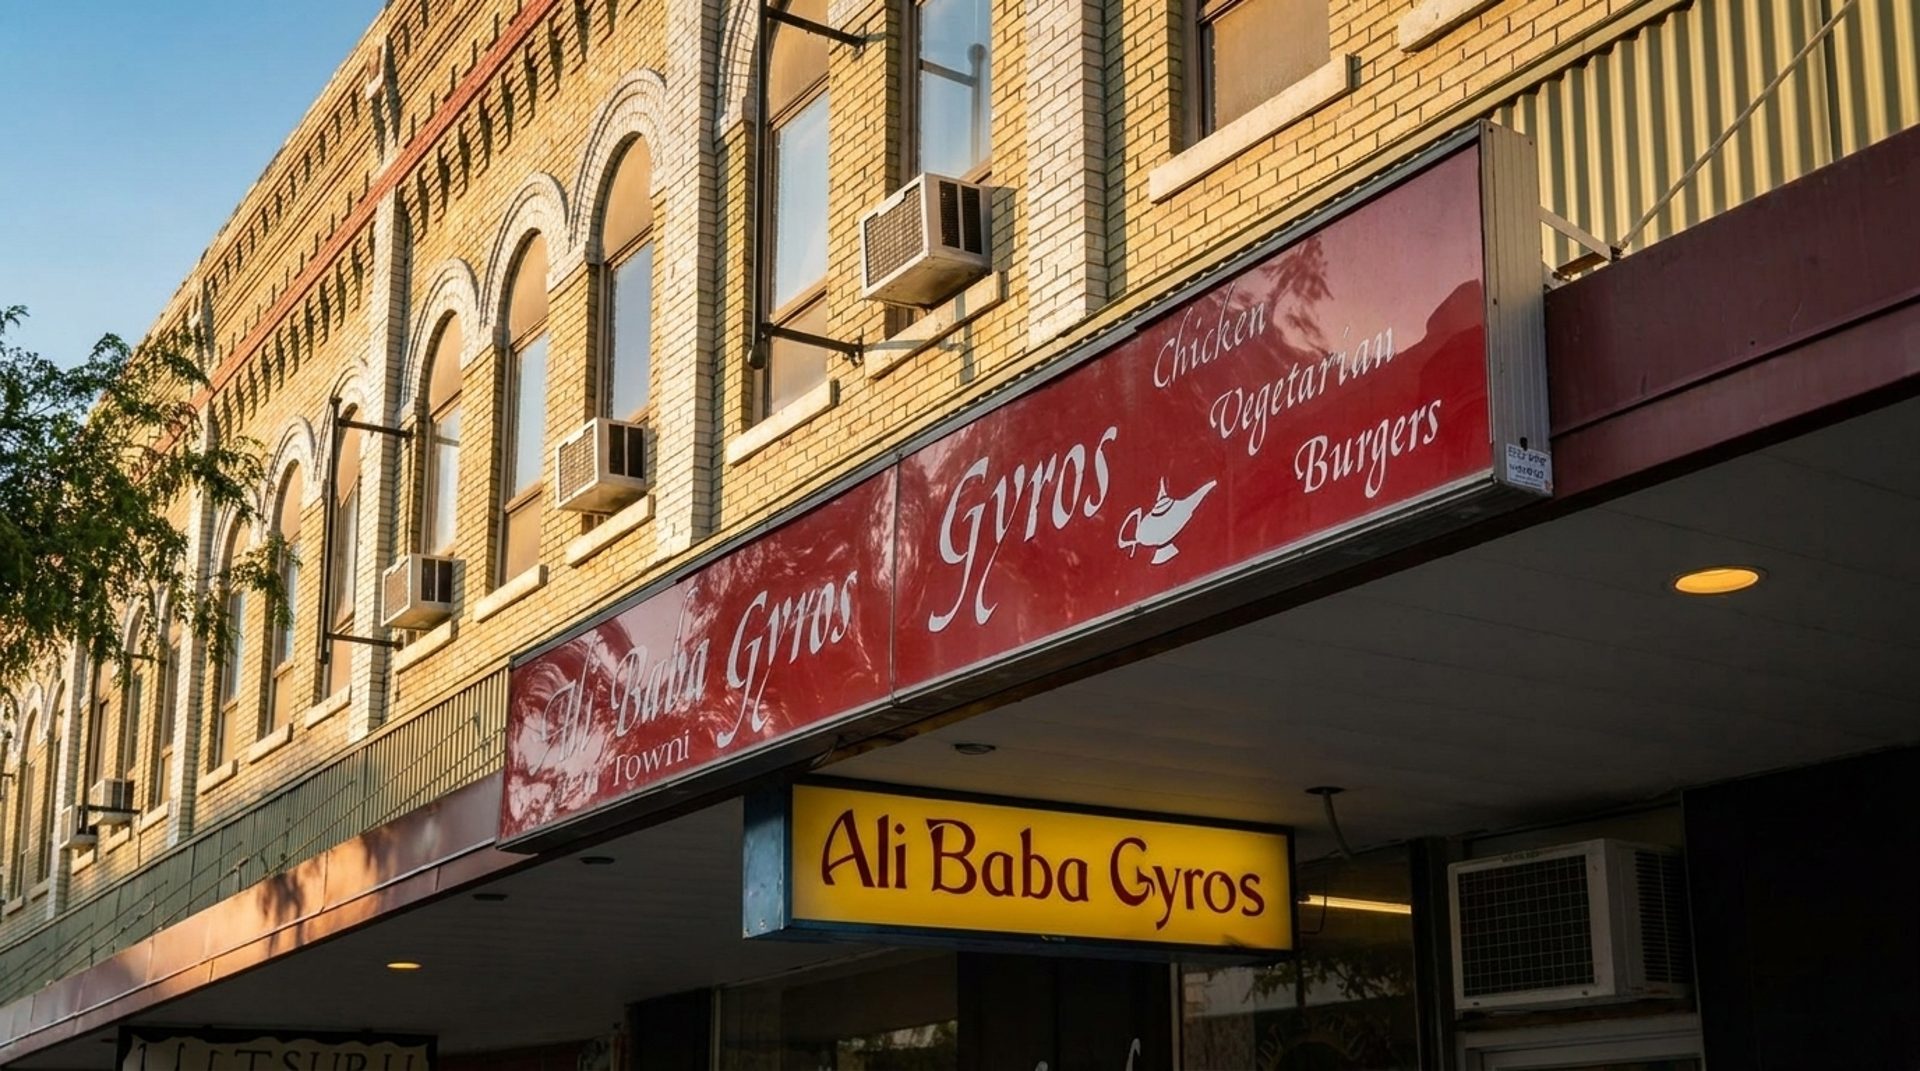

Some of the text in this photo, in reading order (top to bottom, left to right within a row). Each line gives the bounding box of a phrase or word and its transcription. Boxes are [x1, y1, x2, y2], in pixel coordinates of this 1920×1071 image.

[1153, 281, 1266, 388] Chicken
[1210, 326, 1395, 456] Vegetarian
[1294, 399, 1442, 498] Burgers
[928, 426, 1118, 632] Gyros
[610, 586, 711, 738] Baba
[717, 570, 858, 749] Gyros
[821, 809, 1266, 931] Ali Baba Gyros
